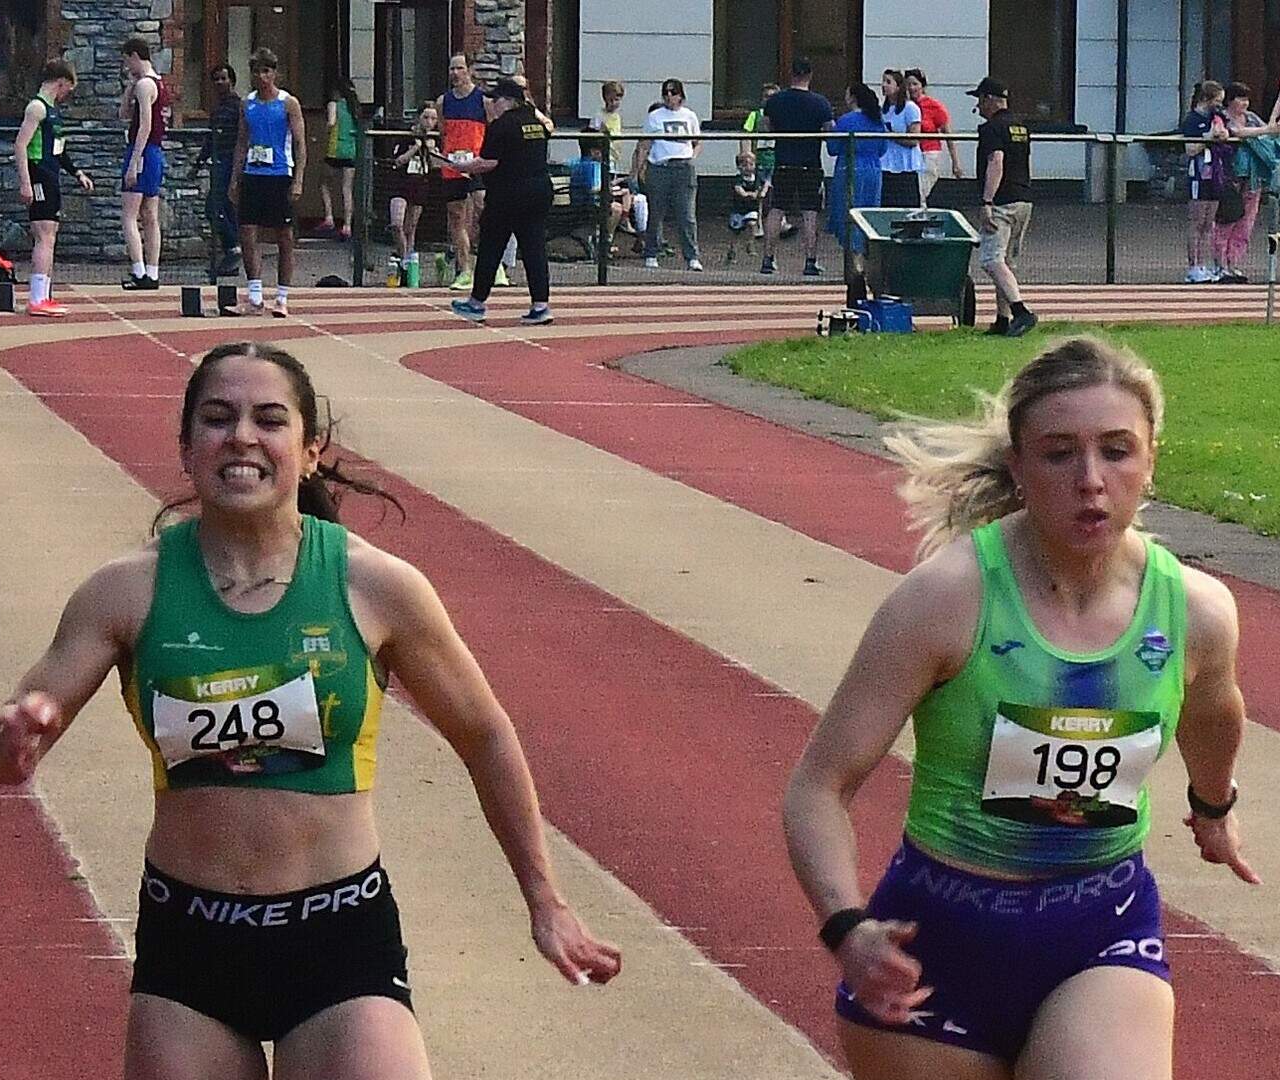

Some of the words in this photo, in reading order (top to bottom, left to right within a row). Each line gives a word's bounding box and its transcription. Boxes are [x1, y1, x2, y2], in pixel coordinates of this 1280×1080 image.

[196, 674, 260, 698] KERRY
[187, 699, 285, 751] 248
[1050, 715, 1114, 733] KERRY
[1032, 742, 1121, 790] 198
[187, 896, 293, 927] NIKE
[301, 870, 382, 921] PRO
[910, 864, 1034, 914] NIKE
[1035, 858, 1136, 913] PRO
